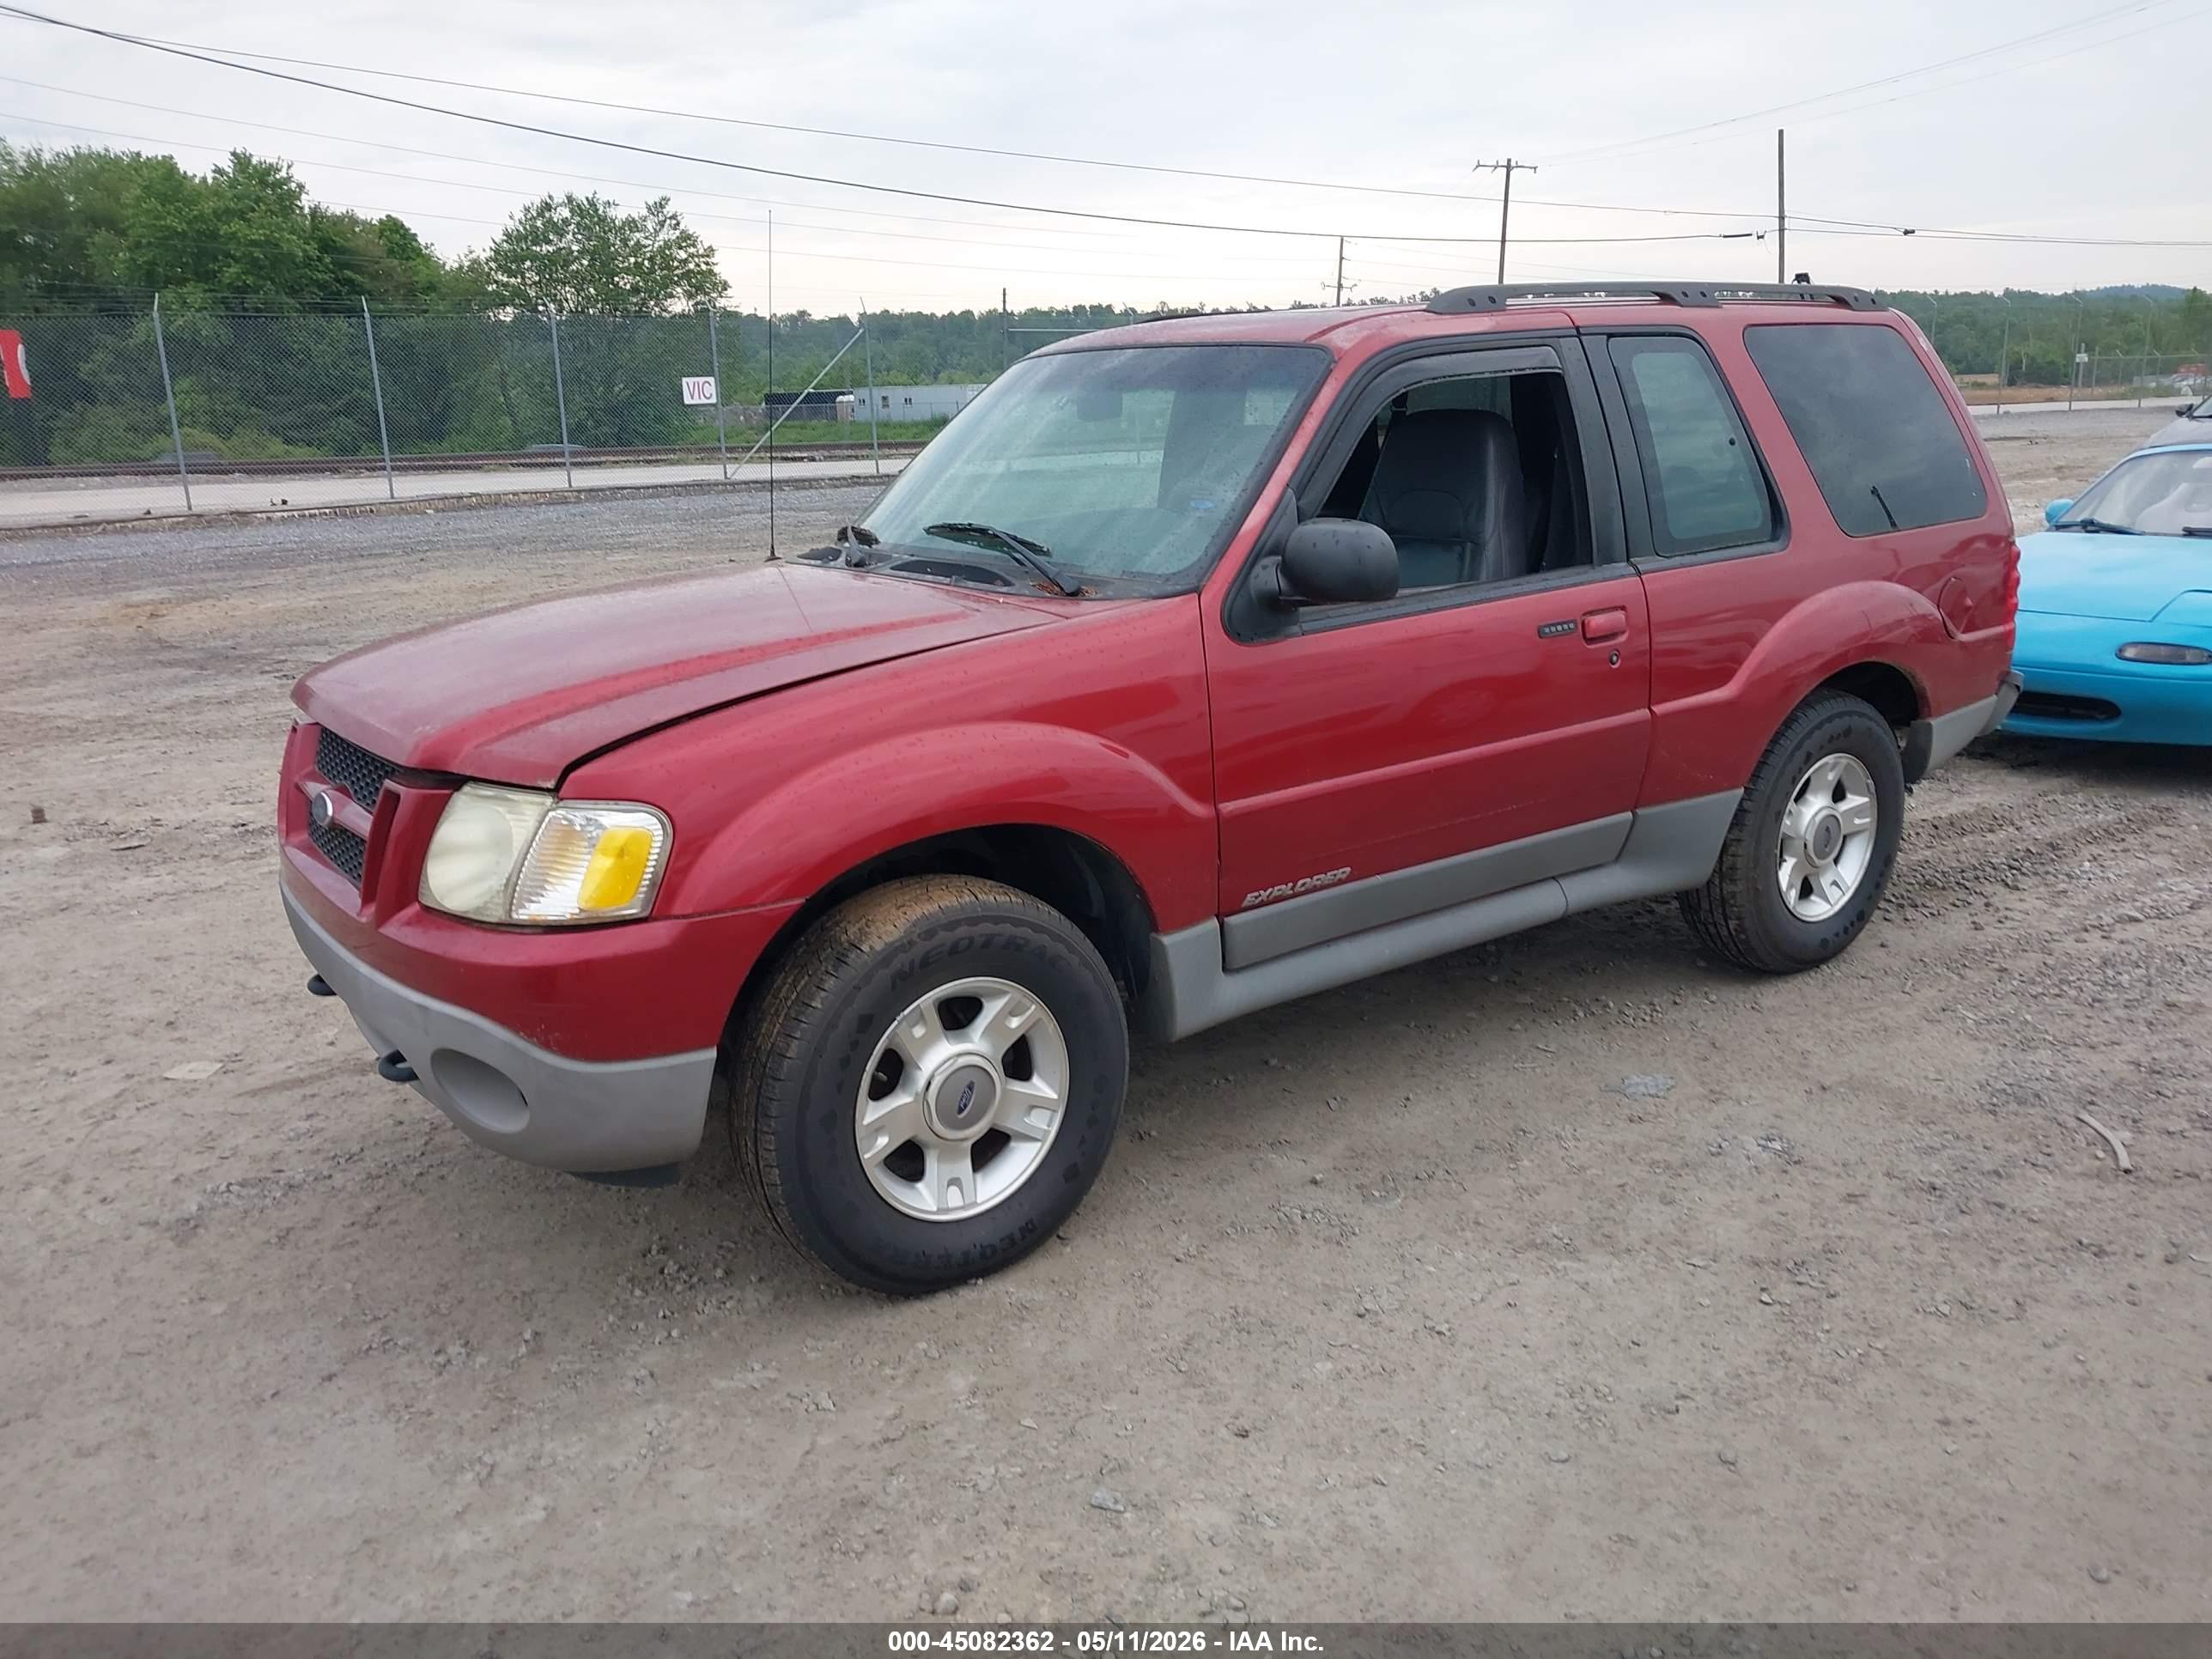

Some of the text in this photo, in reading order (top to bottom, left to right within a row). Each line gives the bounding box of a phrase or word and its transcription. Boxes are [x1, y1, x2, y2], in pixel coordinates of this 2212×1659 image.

[685, 380, 713, 400] VIC
[1241, 866, 1352, 908] EXPLORER
[890, 933, 1071, 991] NEOTRAC
